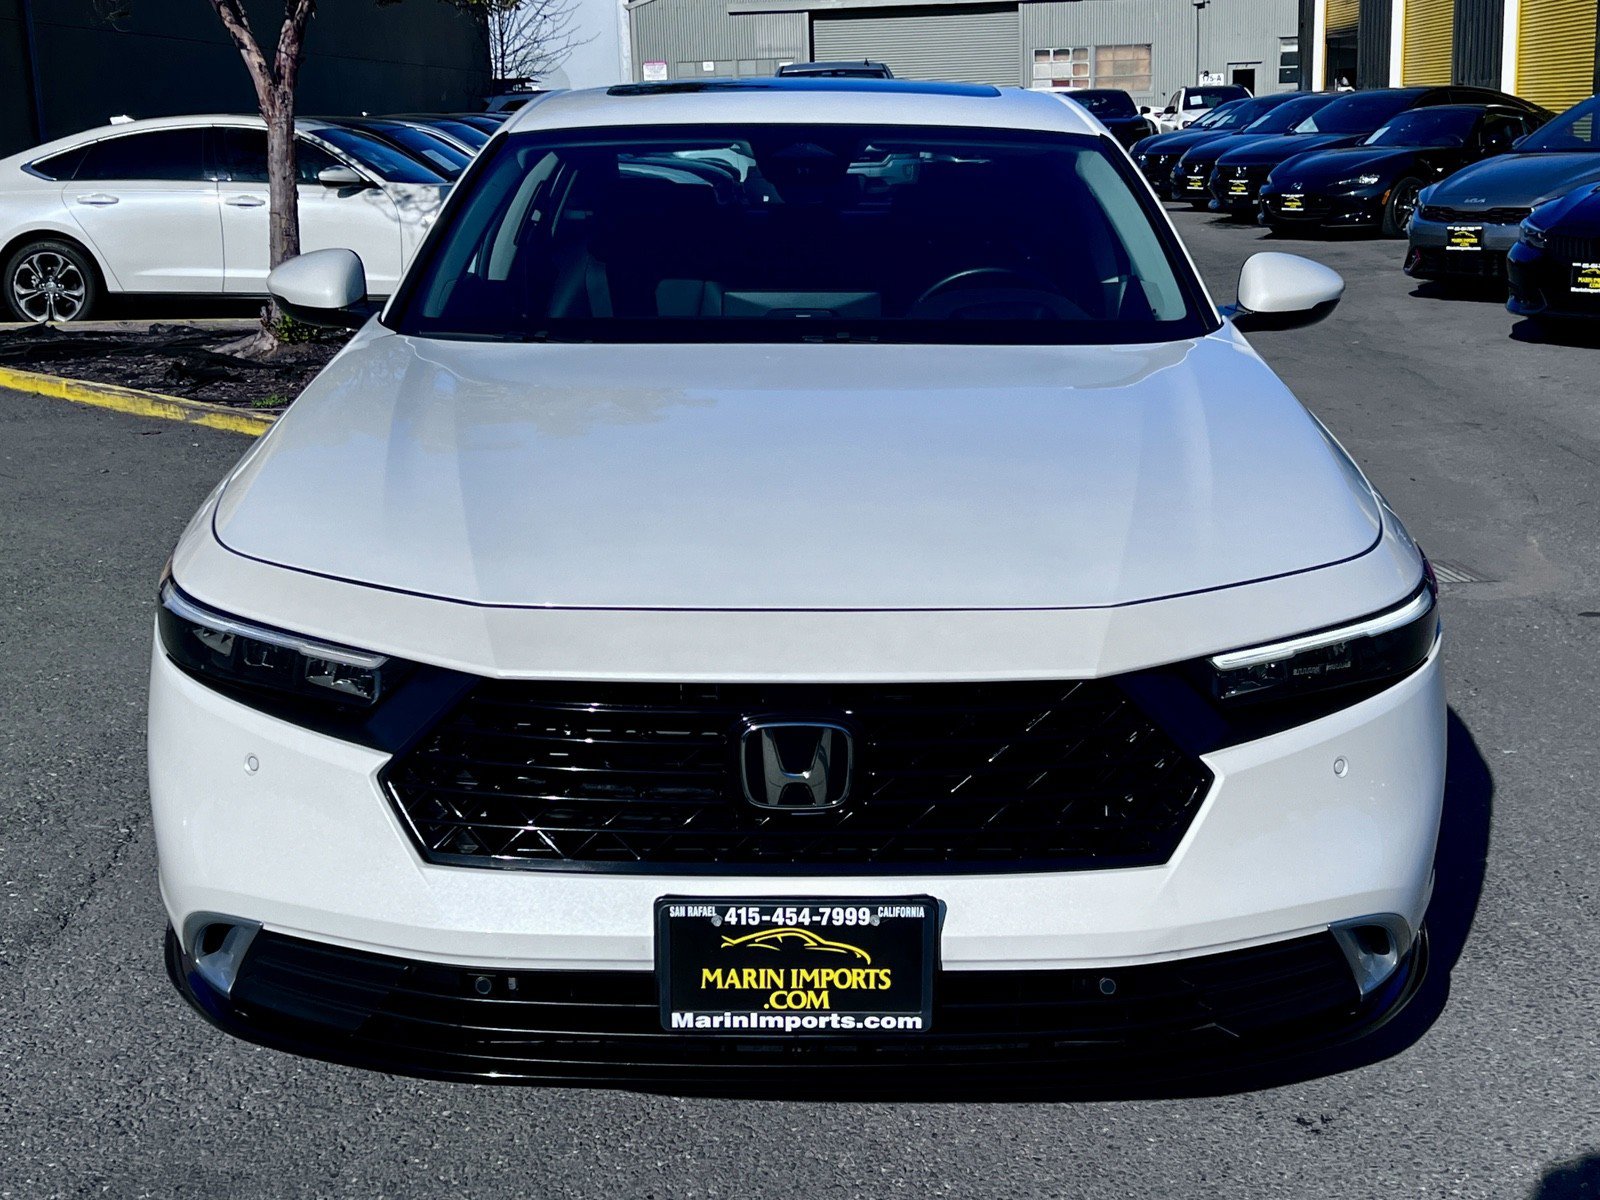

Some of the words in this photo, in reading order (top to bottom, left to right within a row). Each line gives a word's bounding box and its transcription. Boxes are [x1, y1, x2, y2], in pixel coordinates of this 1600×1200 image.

[670, 906, 685, 917] SAN
[687, 905, 717, 918] RAFAEL
[724, 906, 871, 926] 415-454-7999
[877, 906, 925, 918] CALIFORNIA
[700, 968, 785, 990] MARIN
[791, 968, 892, 990] IMPORTS
[763, 990, 831, 1010] .COM
[671, 1012, 923, 1032] MarinImports.com
